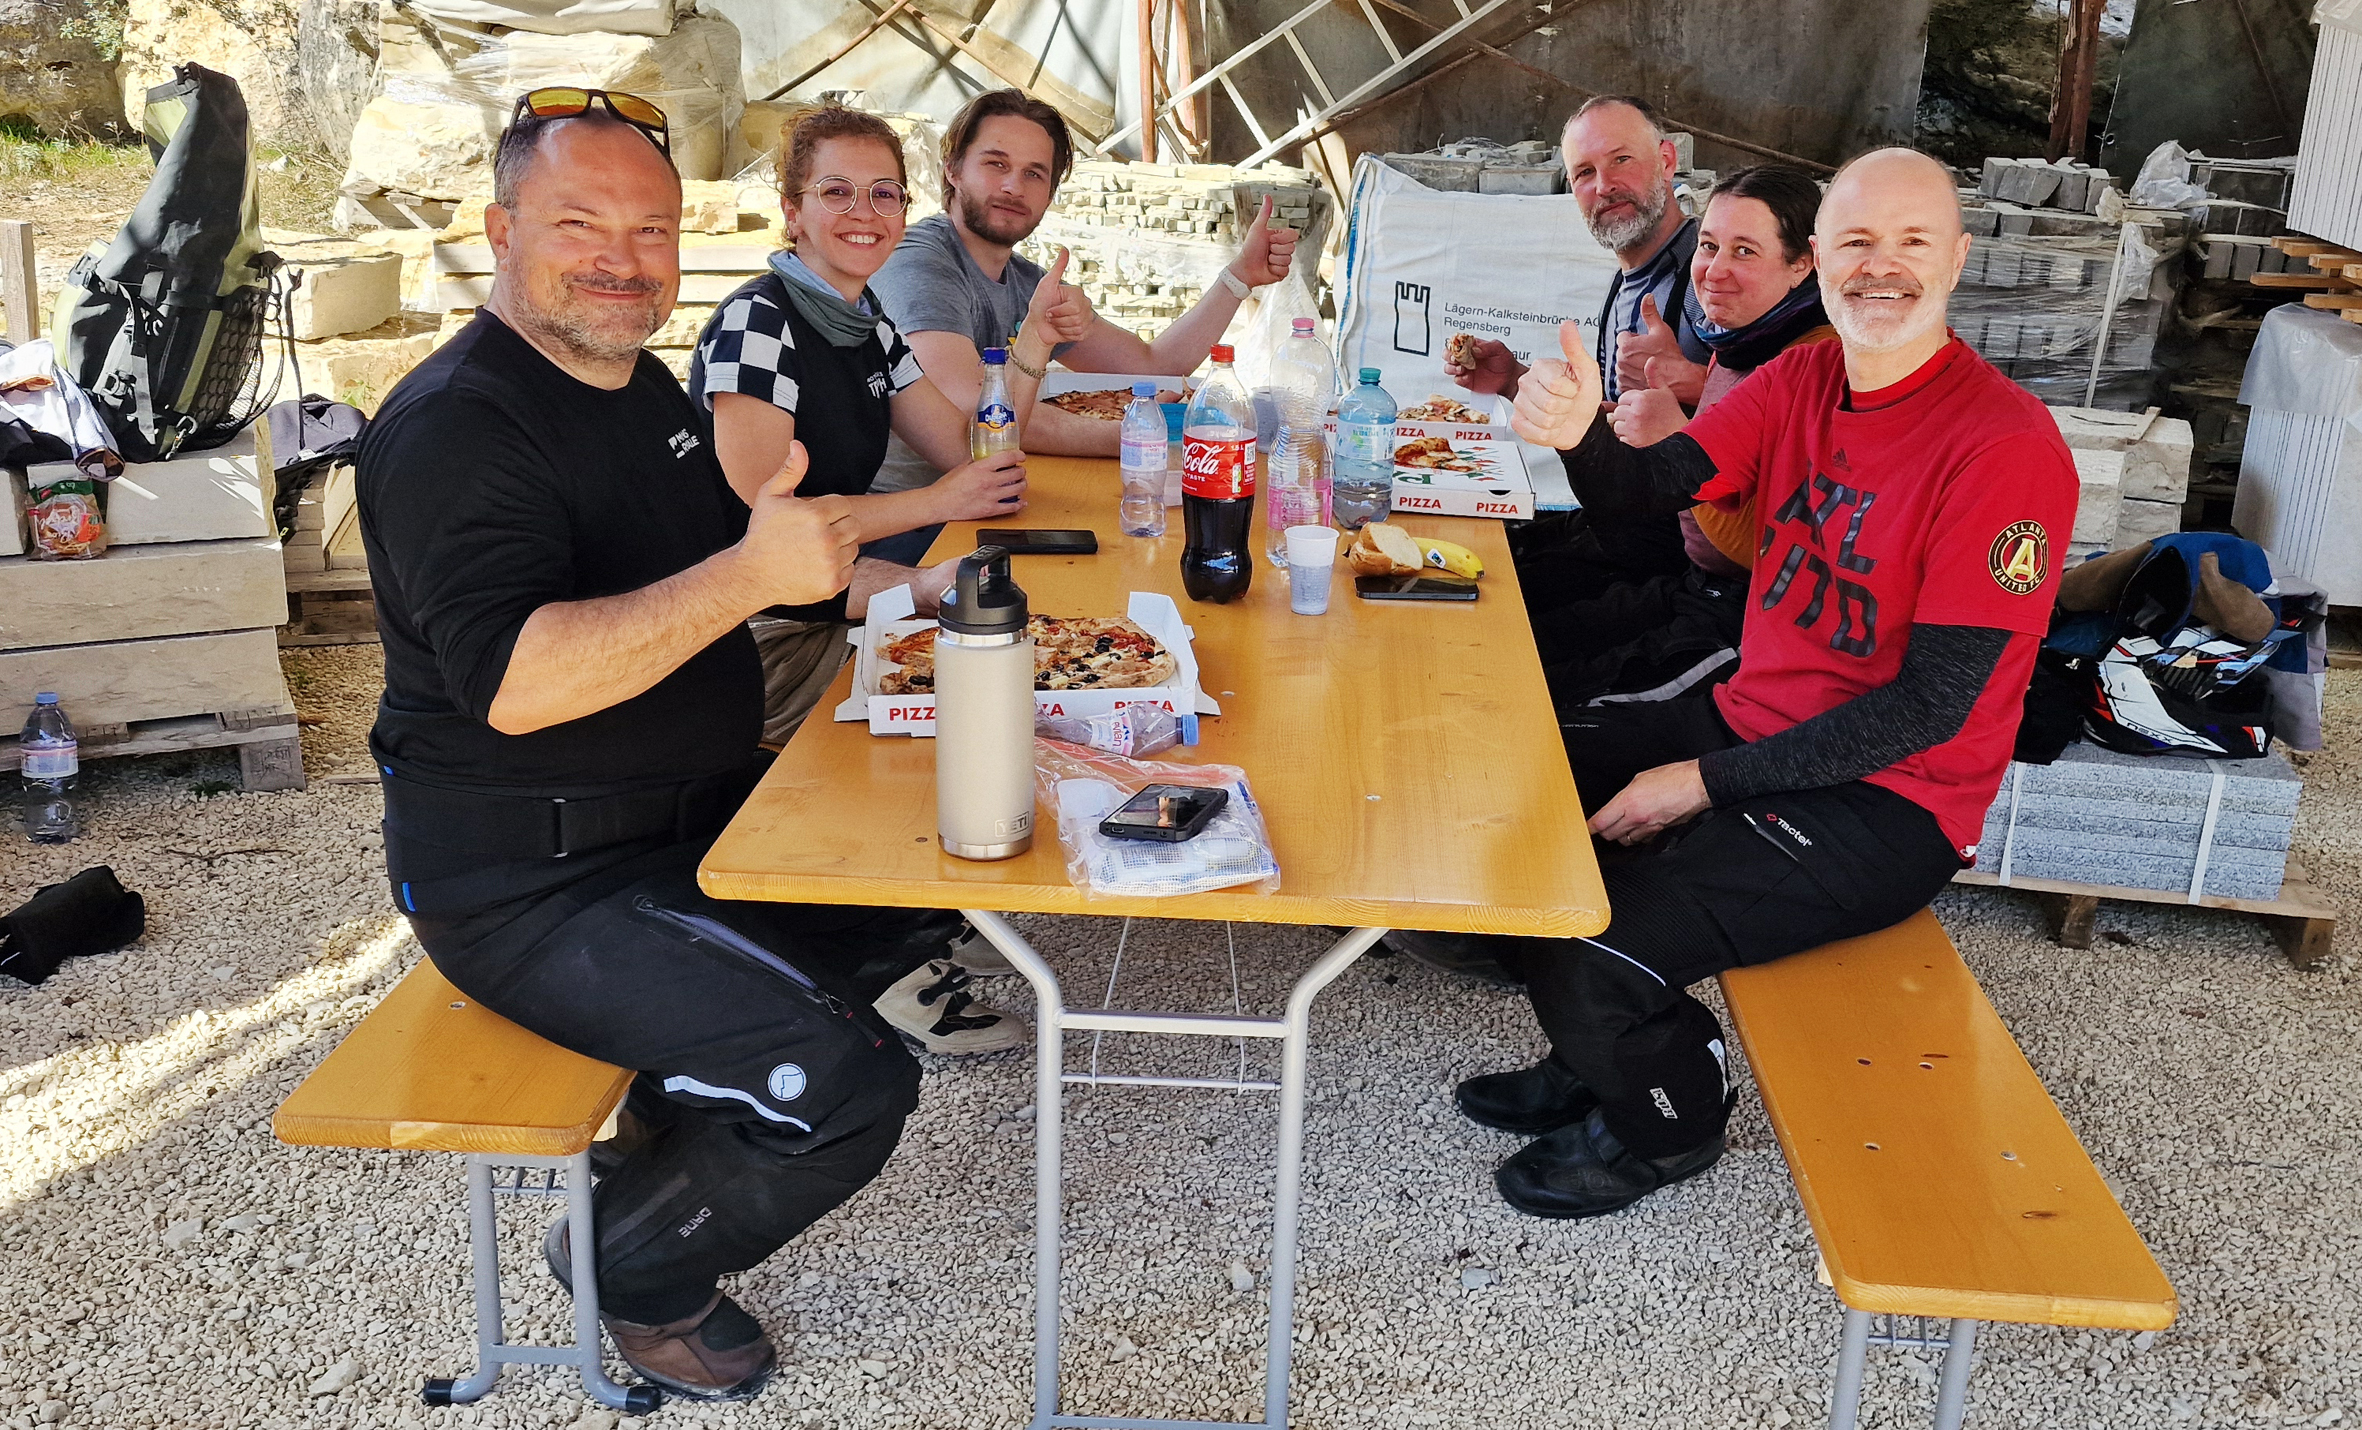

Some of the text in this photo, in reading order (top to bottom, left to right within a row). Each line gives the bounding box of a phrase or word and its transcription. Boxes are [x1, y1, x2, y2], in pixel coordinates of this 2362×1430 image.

[1444, 317, 1511, 337] Regensberg
[1396, 427, 1492, 441] IZZA PIZZA
[1183, 442, 1226, 475] Cola
[1187, 472, 1206, 482] TASTE
[1399, 496, 1519, 515] PIZZA PIZZA
[2005, 523, 2047, 546] ATLANTA
[1994, 568, 2040, 592] UNITED FC
[889, 706, 936, 721] PIZZ
[998, 815, 1028, 834] YETI
[678, 1206, 712, 1238] DANE
